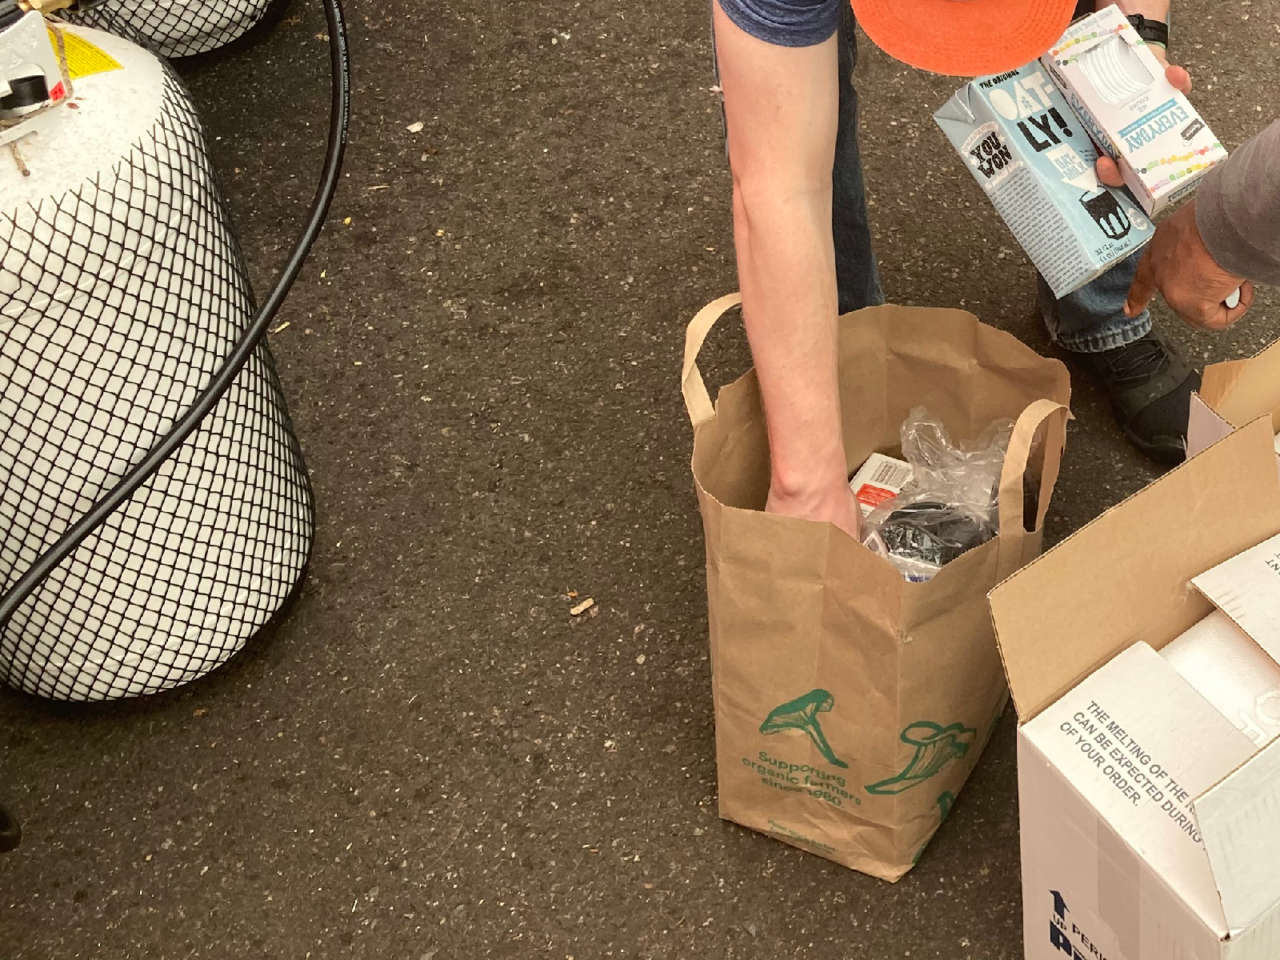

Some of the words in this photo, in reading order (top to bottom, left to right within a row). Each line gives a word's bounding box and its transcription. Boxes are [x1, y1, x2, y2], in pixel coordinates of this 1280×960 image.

[979, 80, 994, 90] THE
[988, 71, 1056, 121] OAT-
[969, 130, 1002, 165] YOU
[1016, 106, 1073, 153] LY!
[1124, 105, 1190, 153] EVERYDAY
[977, 144, 1013, 179] WON
[741, 757, 800, 785] organic
[758, 751, 846, 788] Supporting
[1059, 721, 1078, 738] OF
[1074, 736, 1106, 768] YOUR
[1102, 765, 1143, 807] ORDER.
[1086, 700, 1111, 724] THE
[1105, 721, 1152, 766] MELTING
[1150, 763, 1168, 783] OF
[1163, 777, 1191, 803] THE
[1072, 711, 1097, 736] CAN
[1096, 732, 1113, 751] BE
[1109, 747, 1163, 803] EXPECTED
[1160, 800, 1203, 844] DURING
[1052, 913, 1068, 932] UP
